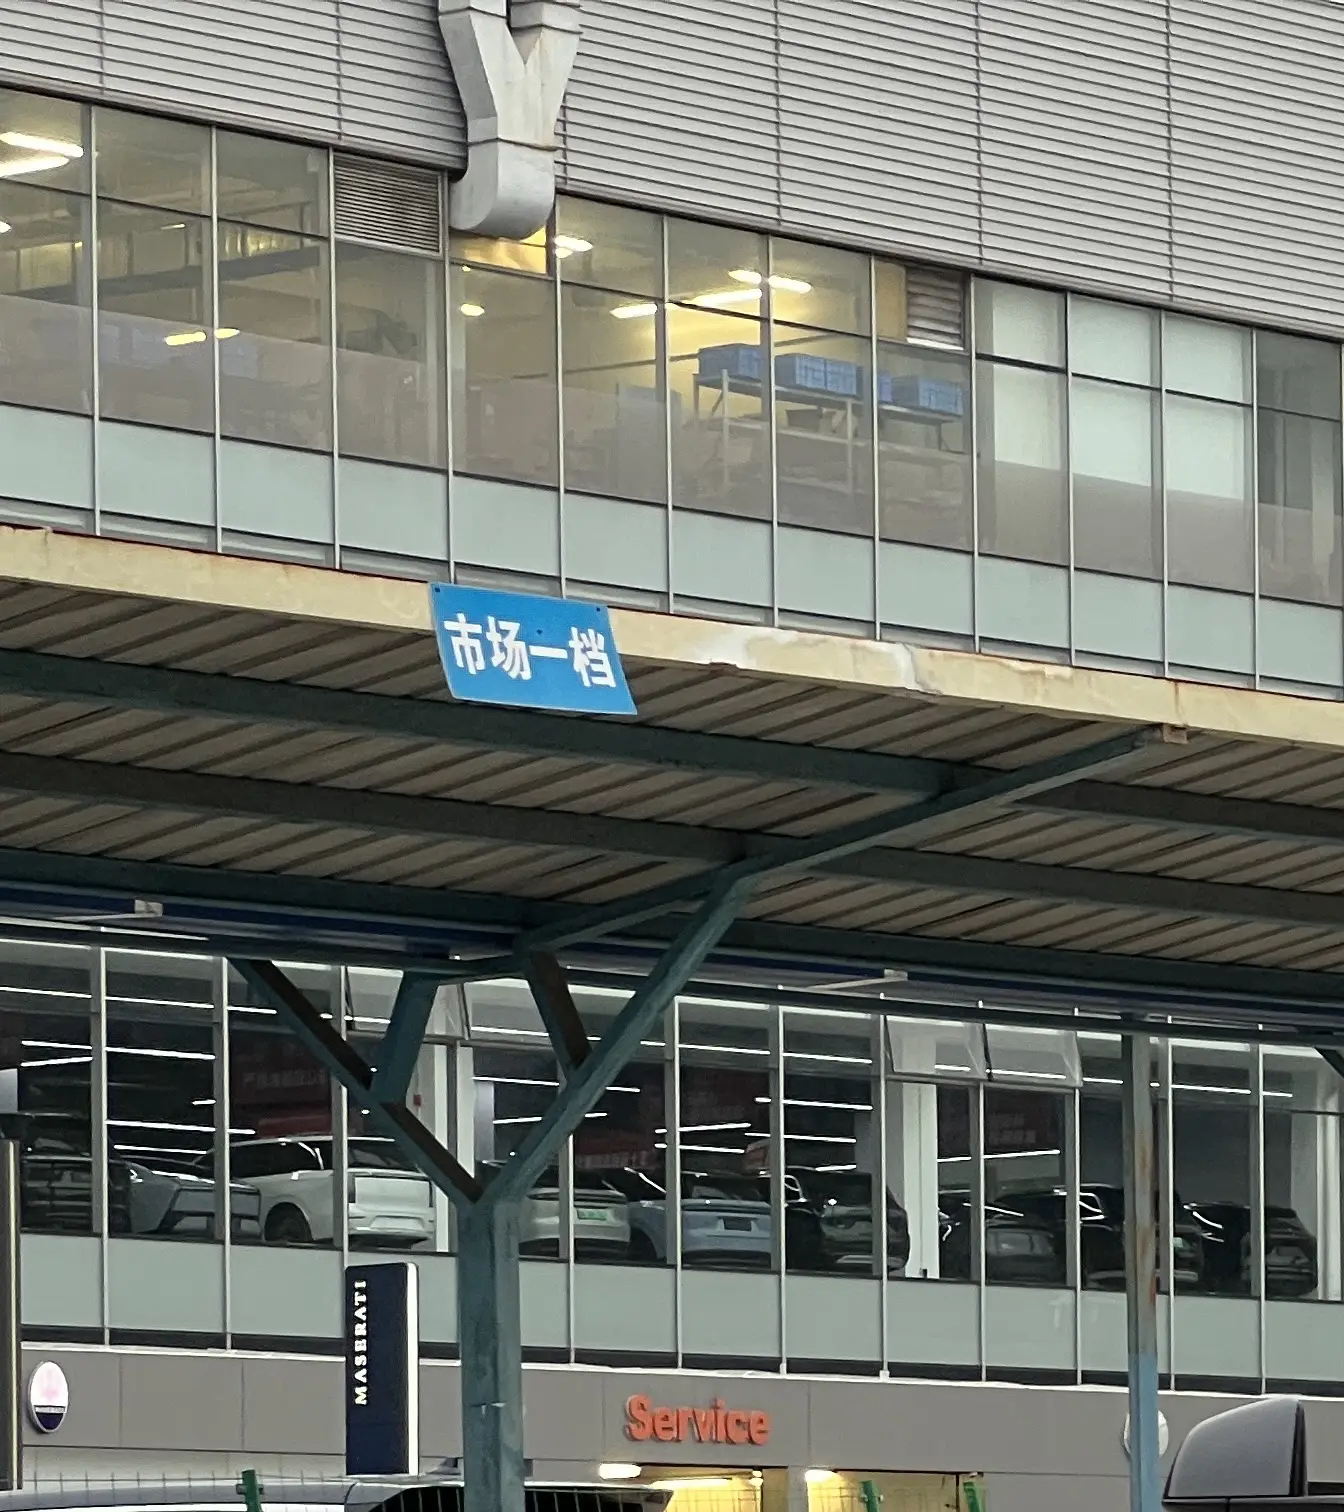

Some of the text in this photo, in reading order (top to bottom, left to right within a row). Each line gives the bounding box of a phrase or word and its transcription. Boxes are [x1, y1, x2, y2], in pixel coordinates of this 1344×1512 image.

[444, 613, 616, 687] 市场一档
[354, 1279, 367, 1406] MASERATI
[625, 1393, 772, 1446] Service
